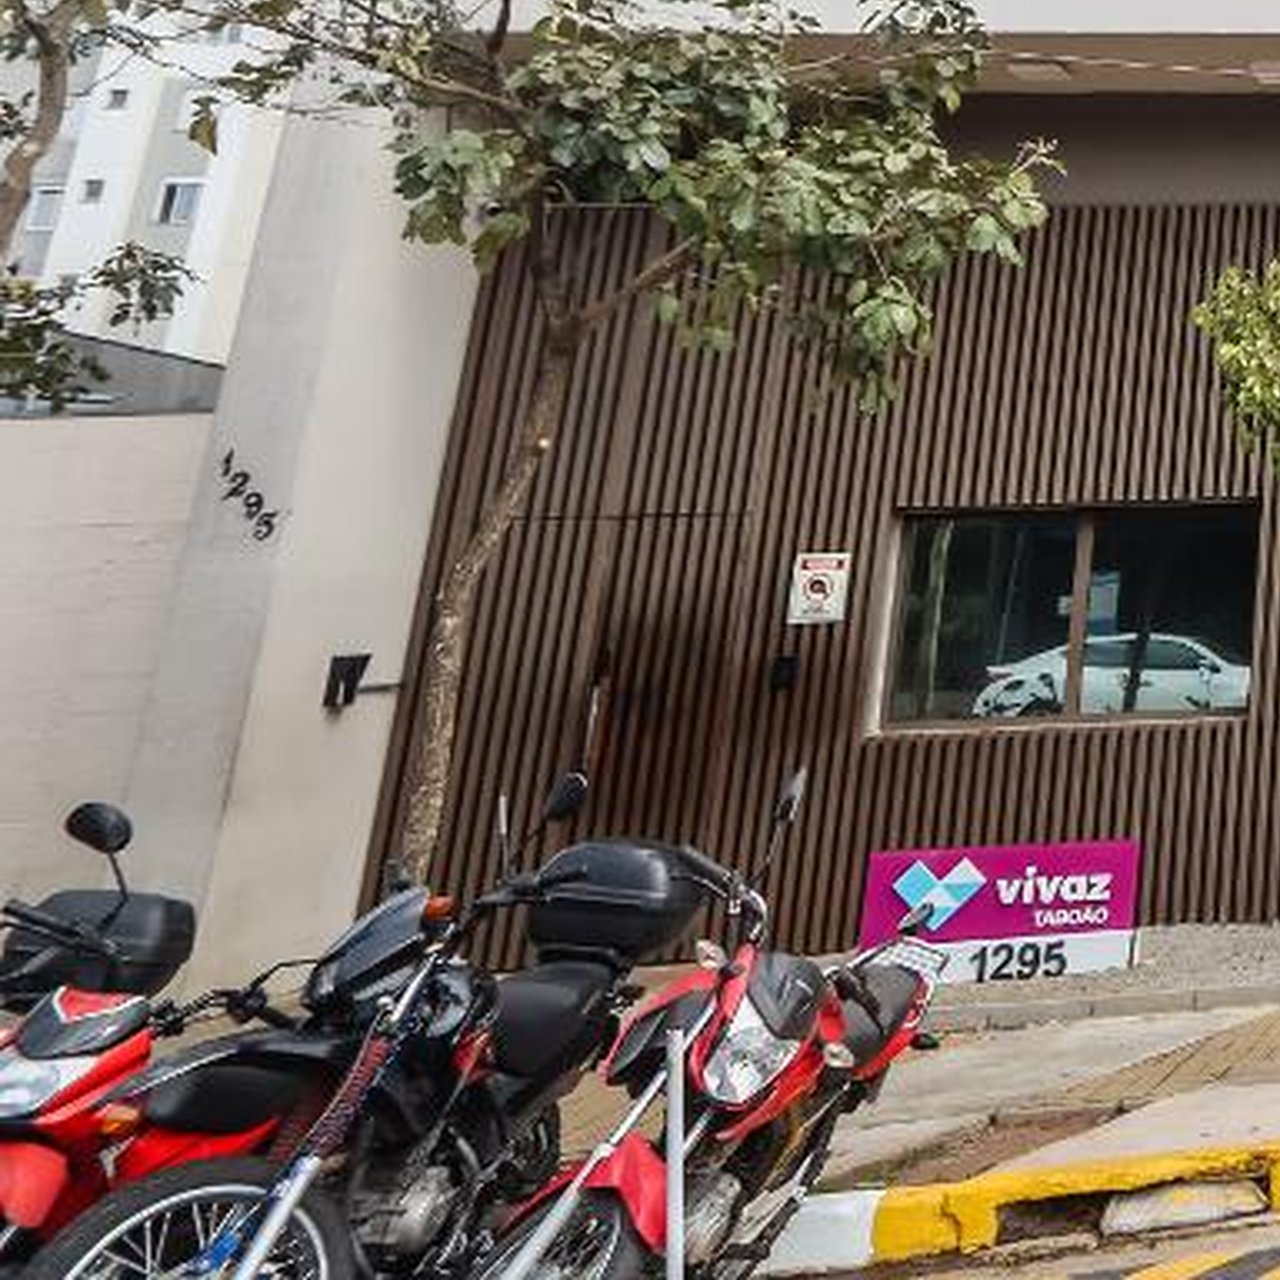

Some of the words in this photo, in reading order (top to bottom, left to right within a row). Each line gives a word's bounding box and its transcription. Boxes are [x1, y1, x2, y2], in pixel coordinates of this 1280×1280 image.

[221, 447, 279, 541] 1295
[996, 865, 1114, 905] vivaz
[969, 940, 1067, 983] 1295
